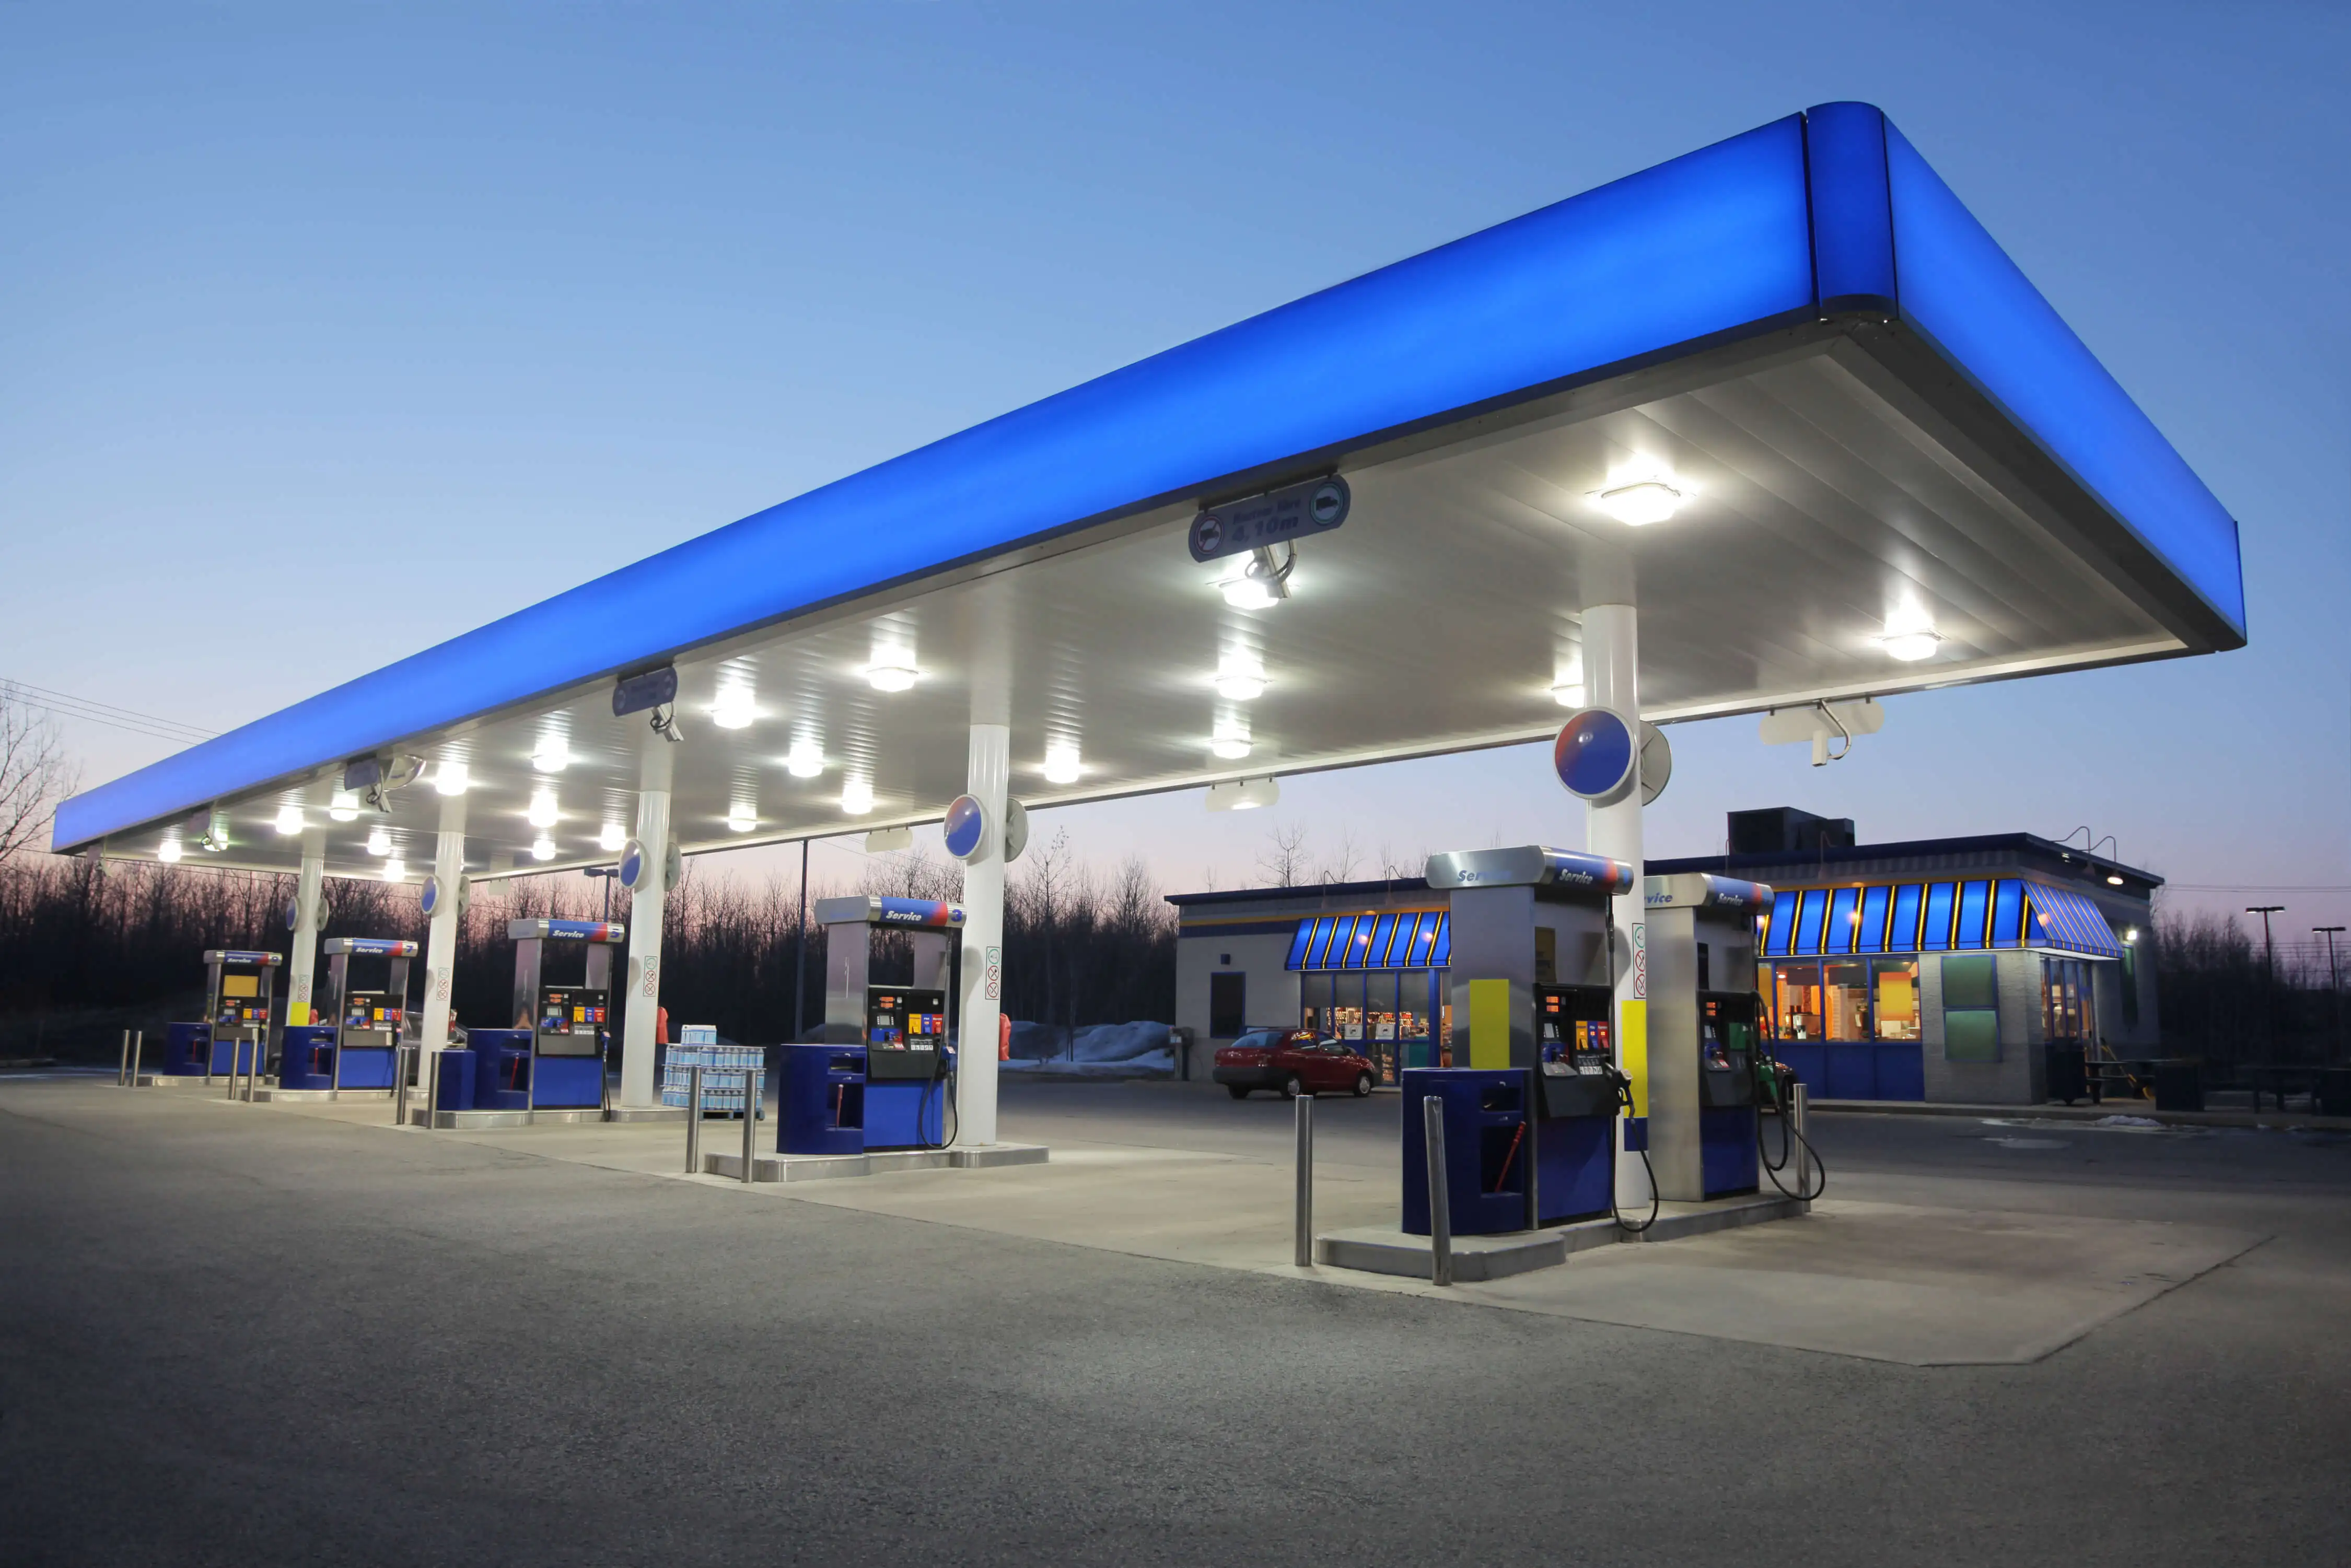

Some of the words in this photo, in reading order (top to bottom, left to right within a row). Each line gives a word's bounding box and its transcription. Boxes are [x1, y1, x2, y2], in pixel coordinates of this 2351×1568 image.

[1559, 868, 1593, 885] Service
[1644, 892, 1673, 904] vice
[1717, 893, 1743, 907] Service
[886, 910, 922, 921] Service
[951, 909, 963, 922] 3
[552, 930, 584, 938] Service
